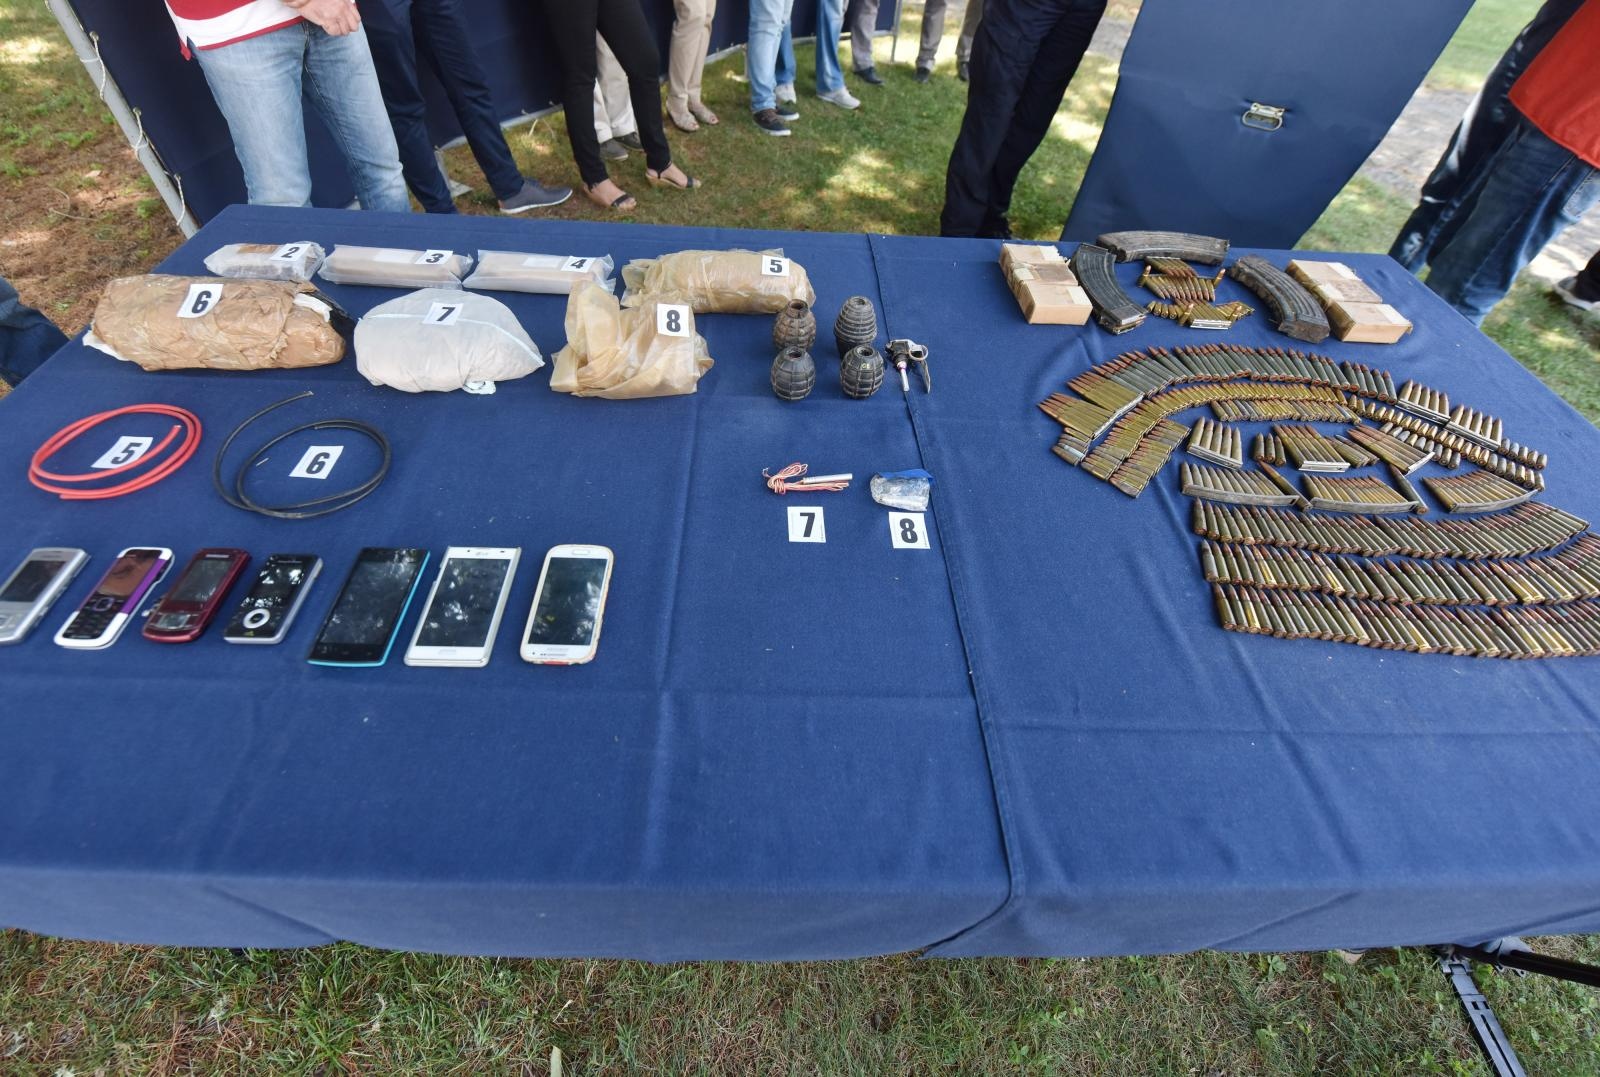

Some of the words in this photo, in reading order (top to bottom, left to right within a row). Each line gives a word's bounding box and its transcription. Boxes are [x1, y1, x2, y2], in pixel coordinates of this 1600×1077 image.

[282, 247, 299, 258] 2
[426, 254, 443, 263] 3
[571, 259, 586, 268] 4
[770, 260, 782, 272] 5
[192, 291, 211, 313] 6
[437, 307, 455, 321] 7
[667, 310, 680, 332] 8
[112, 443, 141, 464] 5
[306, 453, 329, 474] 6
[800, 513, 815, 537] 7
[900, 519, 917, 543] 8
